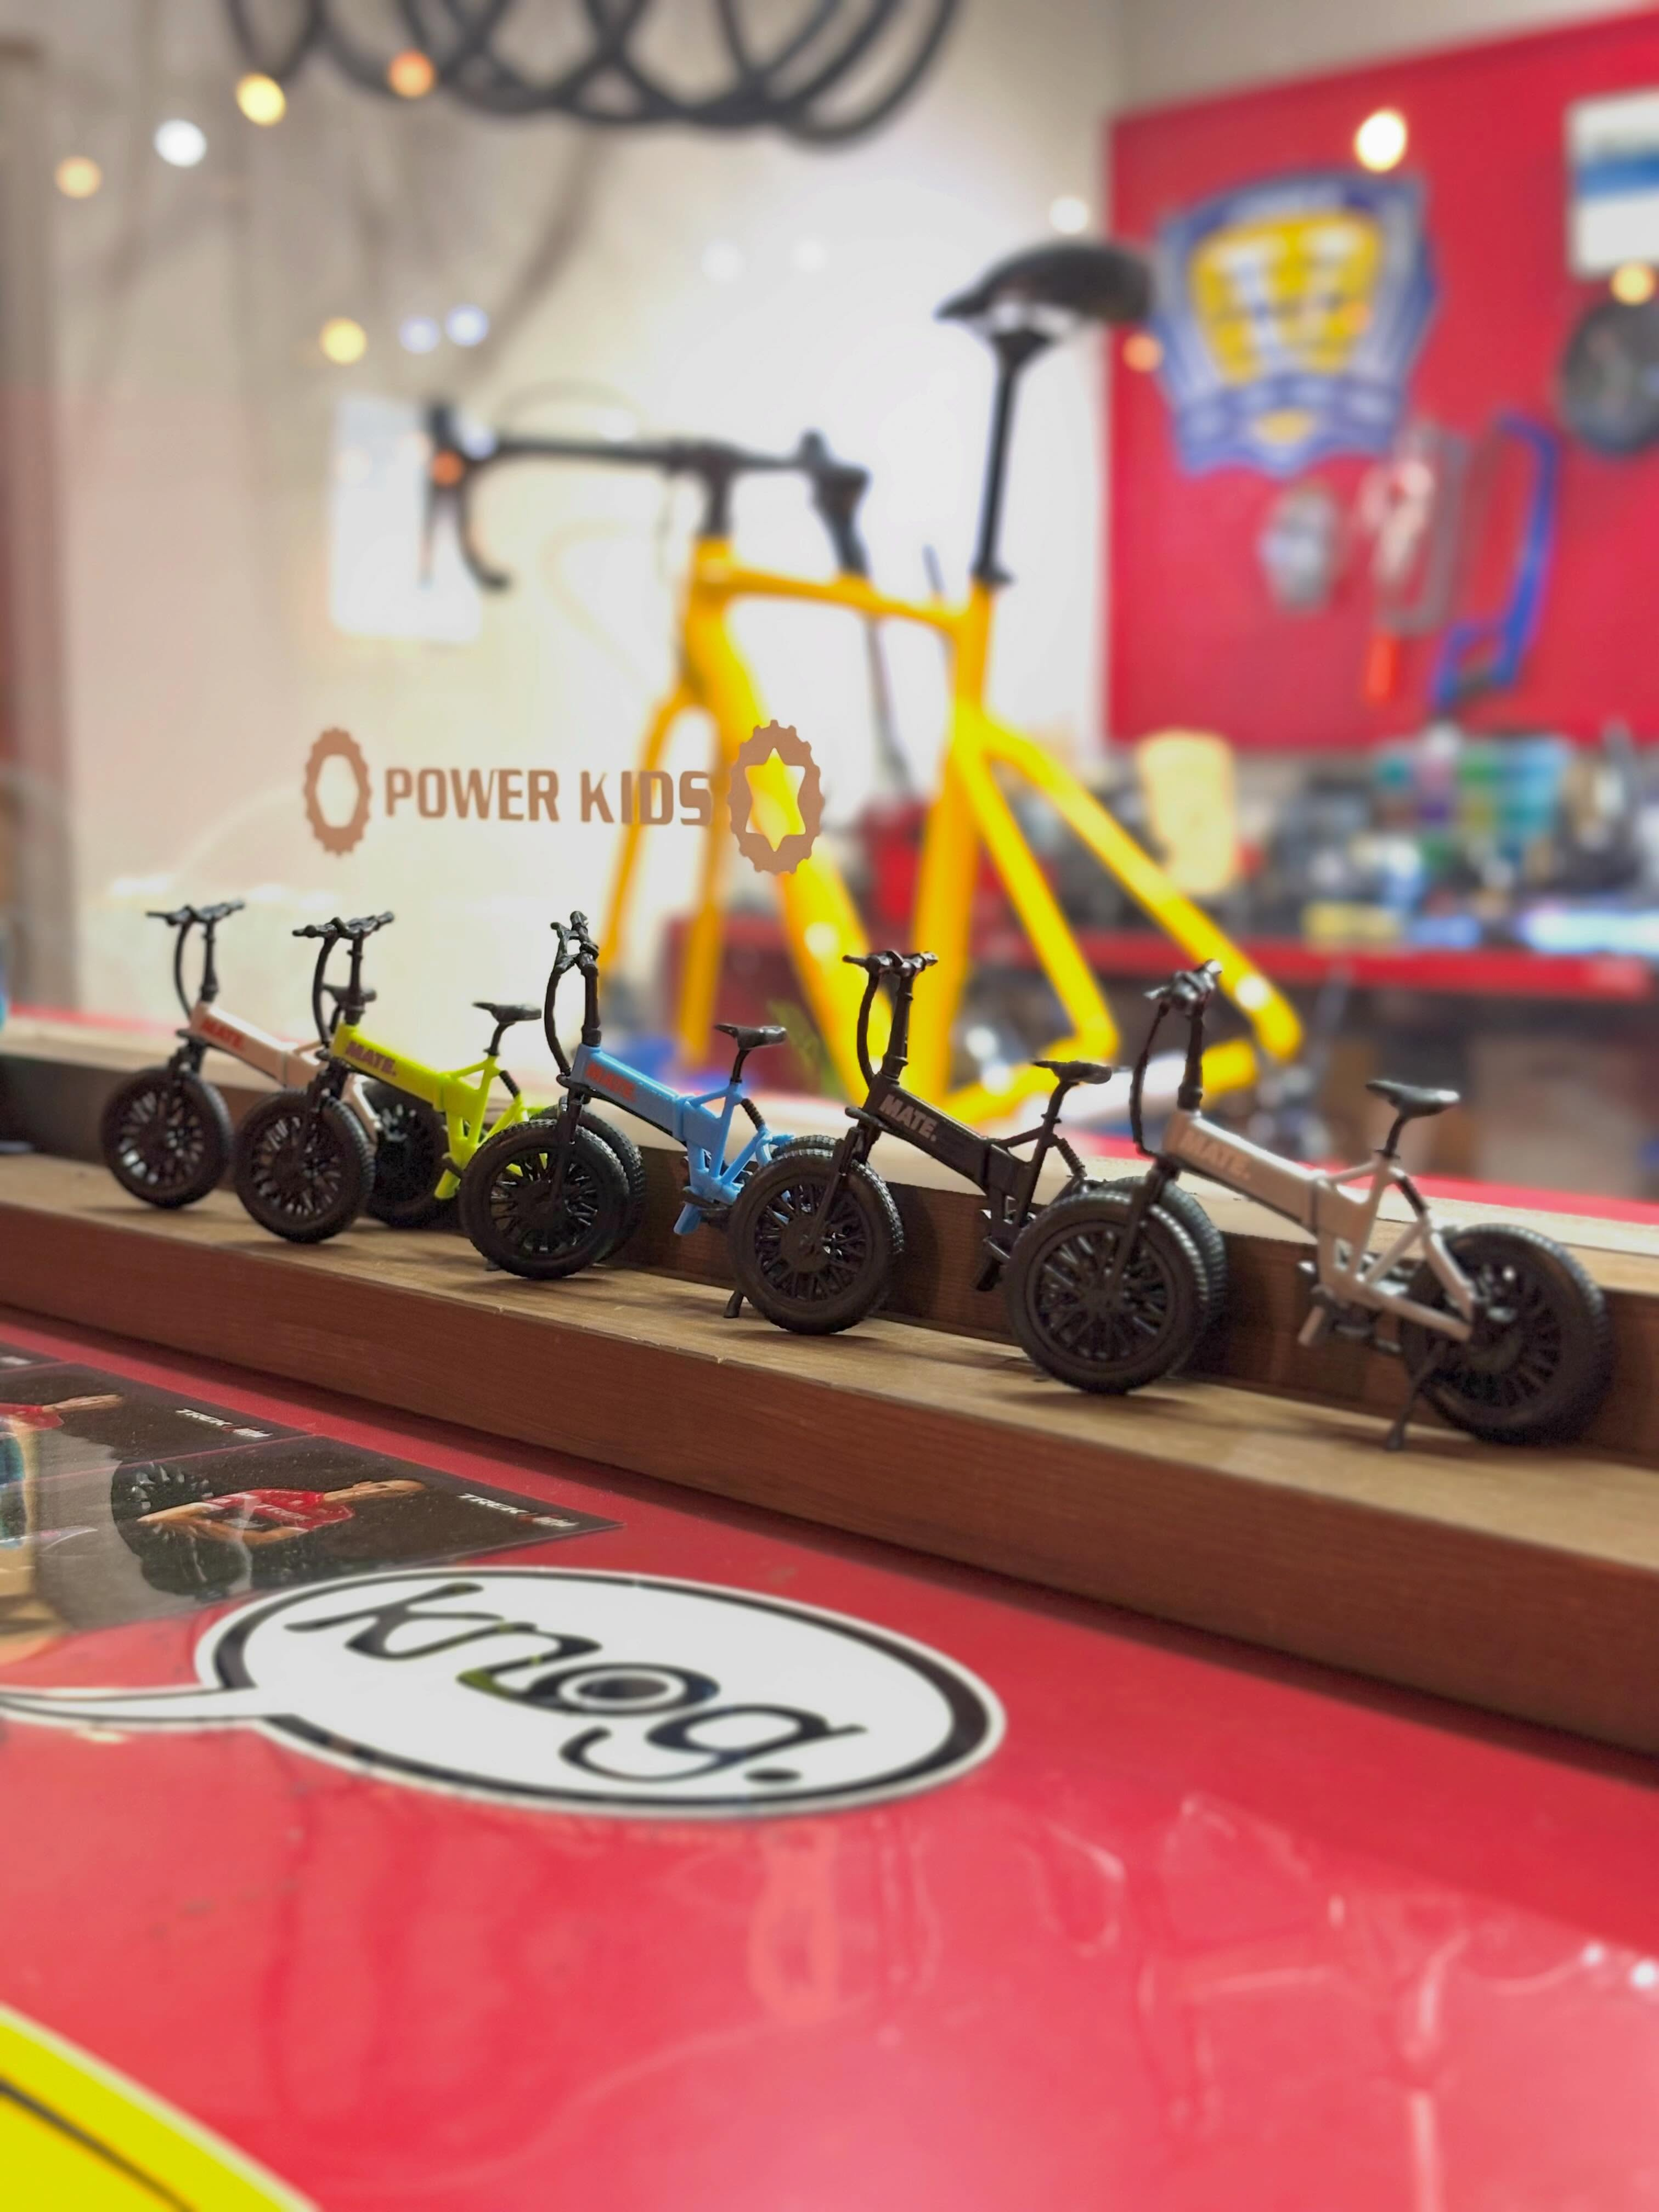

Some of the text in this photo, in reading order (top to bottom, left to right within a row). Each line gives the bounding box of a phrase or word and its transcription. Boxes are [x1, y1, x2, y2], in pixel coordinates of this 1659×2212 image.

[385, 768, 711, 825] POWER KIDS
[345, 1041, 397, 1076] MATE.
[878, 1094, 936, 1141] MATE.
[1178, 1130, 1251, 1180] MATE.
[175, 1408, 233, 1426] TREK
[456, 1493, 529, 1514] TREK
